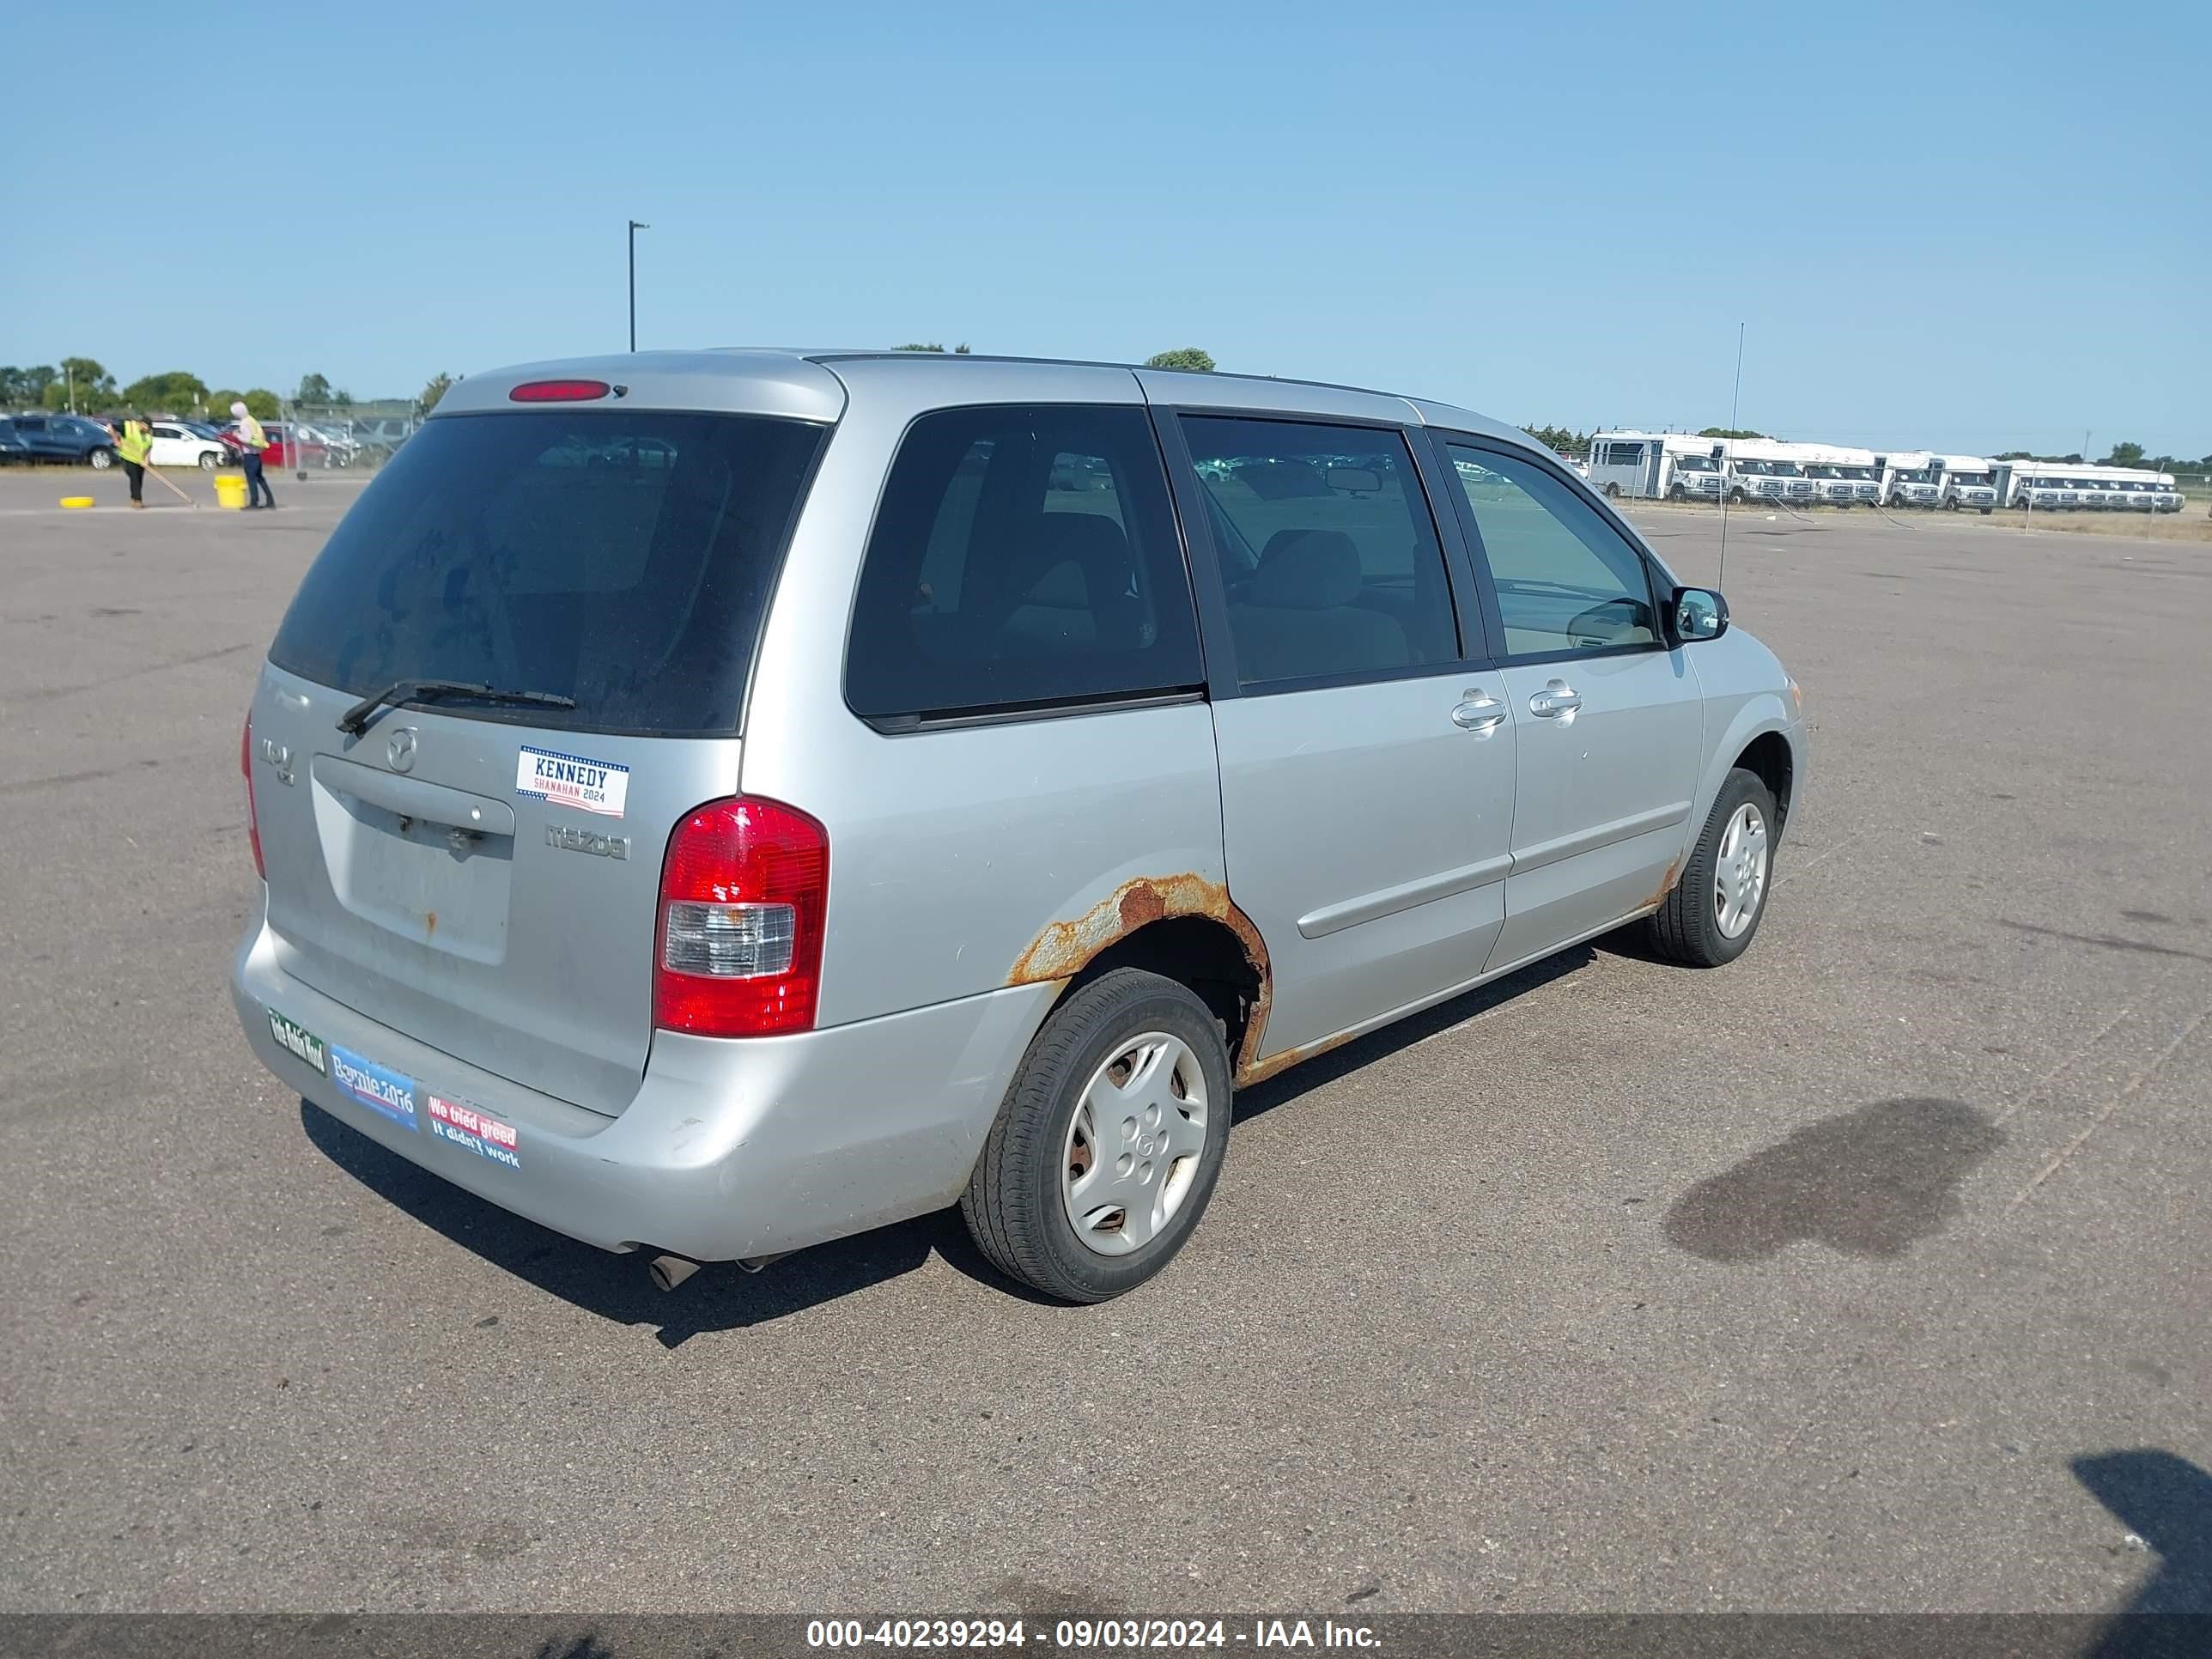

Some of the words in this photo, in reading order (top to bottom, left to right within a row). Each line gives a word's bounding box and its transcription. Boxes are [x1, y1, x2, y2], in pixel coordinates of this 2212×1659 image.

[534, 777, 580, 798] SHANAHAN
[583, 788, 605, 803] 2024
[535, 757, 608, 789] KENNEDY
[331, 1054, 380, 1097] Bernie
[380, 1080, 414, 1113] 2016
[429, 1096, 447, 1118] We
[449, 1105, 478, 1132] tried
[480, 1119, 517, 1147] greed
[432, 1119, 445, 1136] It
[446, 1126, 483, 1156] didn't
[485, 1145, 520, 1169] work
